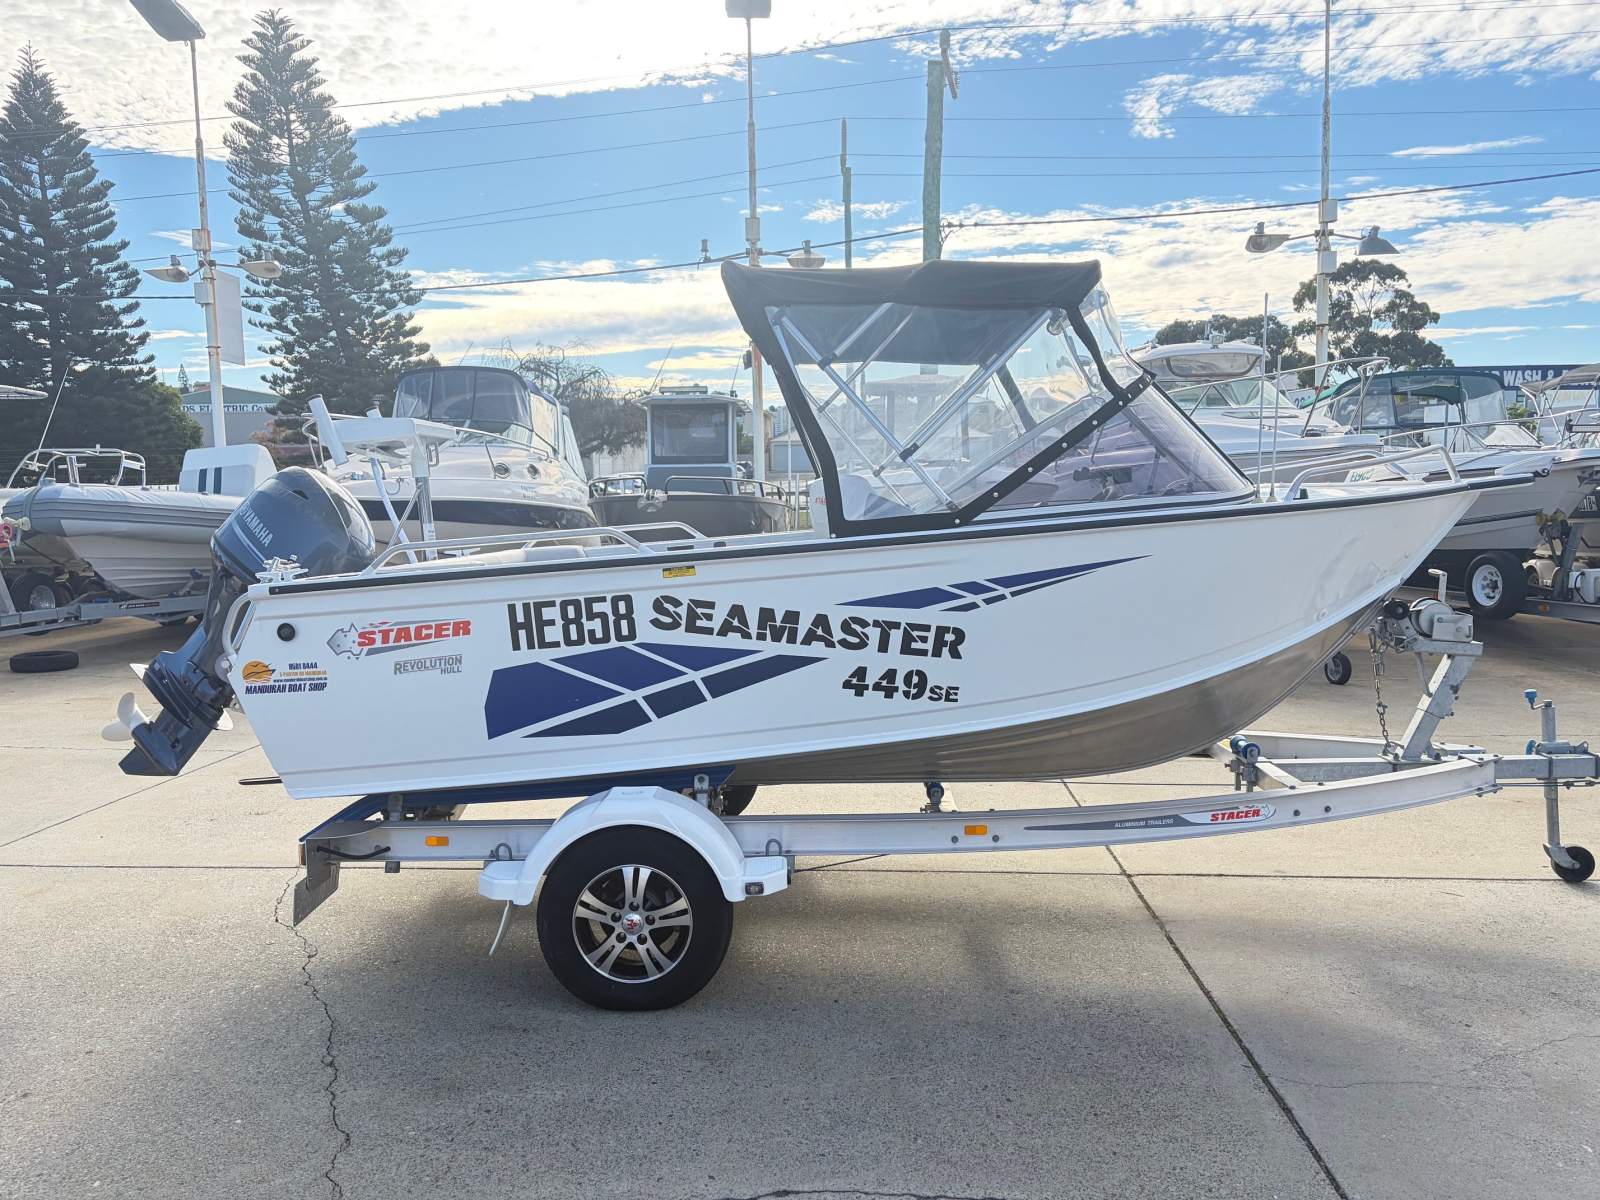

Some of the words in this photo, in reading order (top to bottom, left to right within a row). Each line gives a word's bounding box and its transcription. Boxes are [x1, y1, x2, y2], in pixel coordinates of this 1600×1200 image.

[1503, 370, 1541, 386] WASH
[243, 509, 273, 547] YAMAHA
[357, 619, 472, 648] STACER
[507, 593, 638, 652] HE858
[649, 594, 967, 660] SEAMASTER
[394, 654, 463, 676] REVOLUTION
[440, 664, 463, 675] HULL
[245, 684, 287, 694] MANDURAH
[287, 682, 307, 693] BOAT
[308, 681, 328, 692] SHOP
[1210, 808, 1261, 823] STACER
